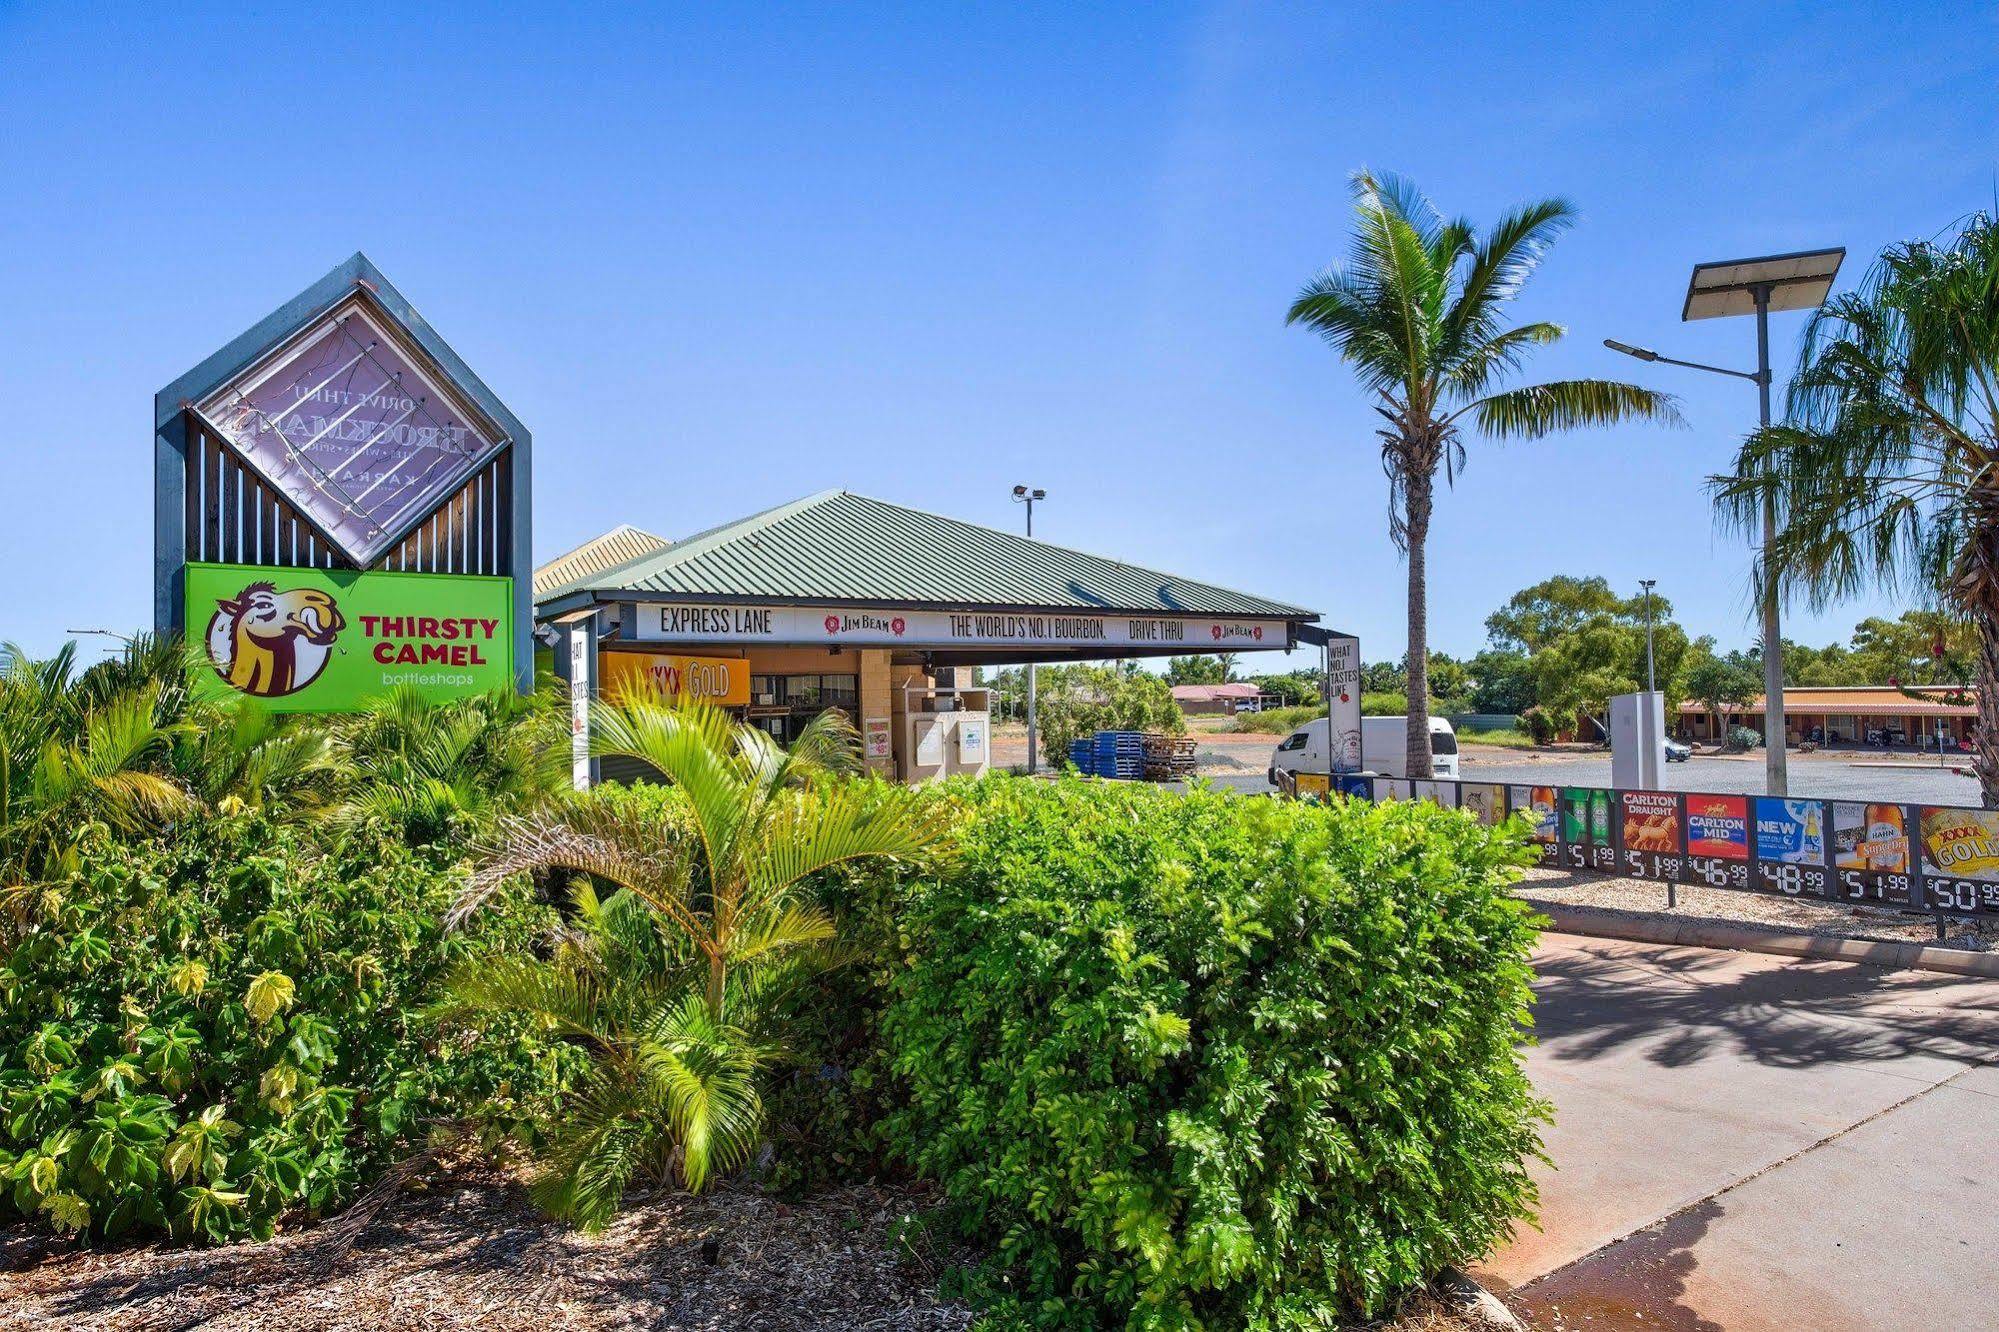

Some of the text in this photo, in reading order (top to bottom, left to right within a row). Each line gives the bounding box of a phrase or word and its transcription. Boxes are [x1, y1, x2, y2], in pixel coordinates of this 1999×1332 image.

[359, 616, 499, 640] THIRSTY
[661, 607, 771, 633] EXPRESS LANE
[841, 615, 889, 633] JIM BEAM
[950, 615, 971, 637] THE
[975, 616, 1025, 637] WORLD'S
[1055, 618, 1106, 640] BOURBON.
[1129, 620, 1183, 640] DRIVE THRU
[373, 642, 487, 666] CAMEL
[571, 641, 582, 660] HAT
[1330, 645, 1350, 659] WHAT
[382, 672, 474, 687] bottleshops
[688, 662, 730, 699] GOLD
[1331, 670, 1358, 685] TASTES
[573, 681, 589, 701] STES
[1623, 793, 1678, 807] CARLTON
[1628, 805, 1673, 816] DRAUGHT
[1689, 815, 1744, 830] CARLTON
[1757, 820, 1797, 835] NEW
[1704, 828, 1730, 839] MID
[1872, 829, 1894, 839] HAHN
[1940, 825, 1982, 843] XXXX
